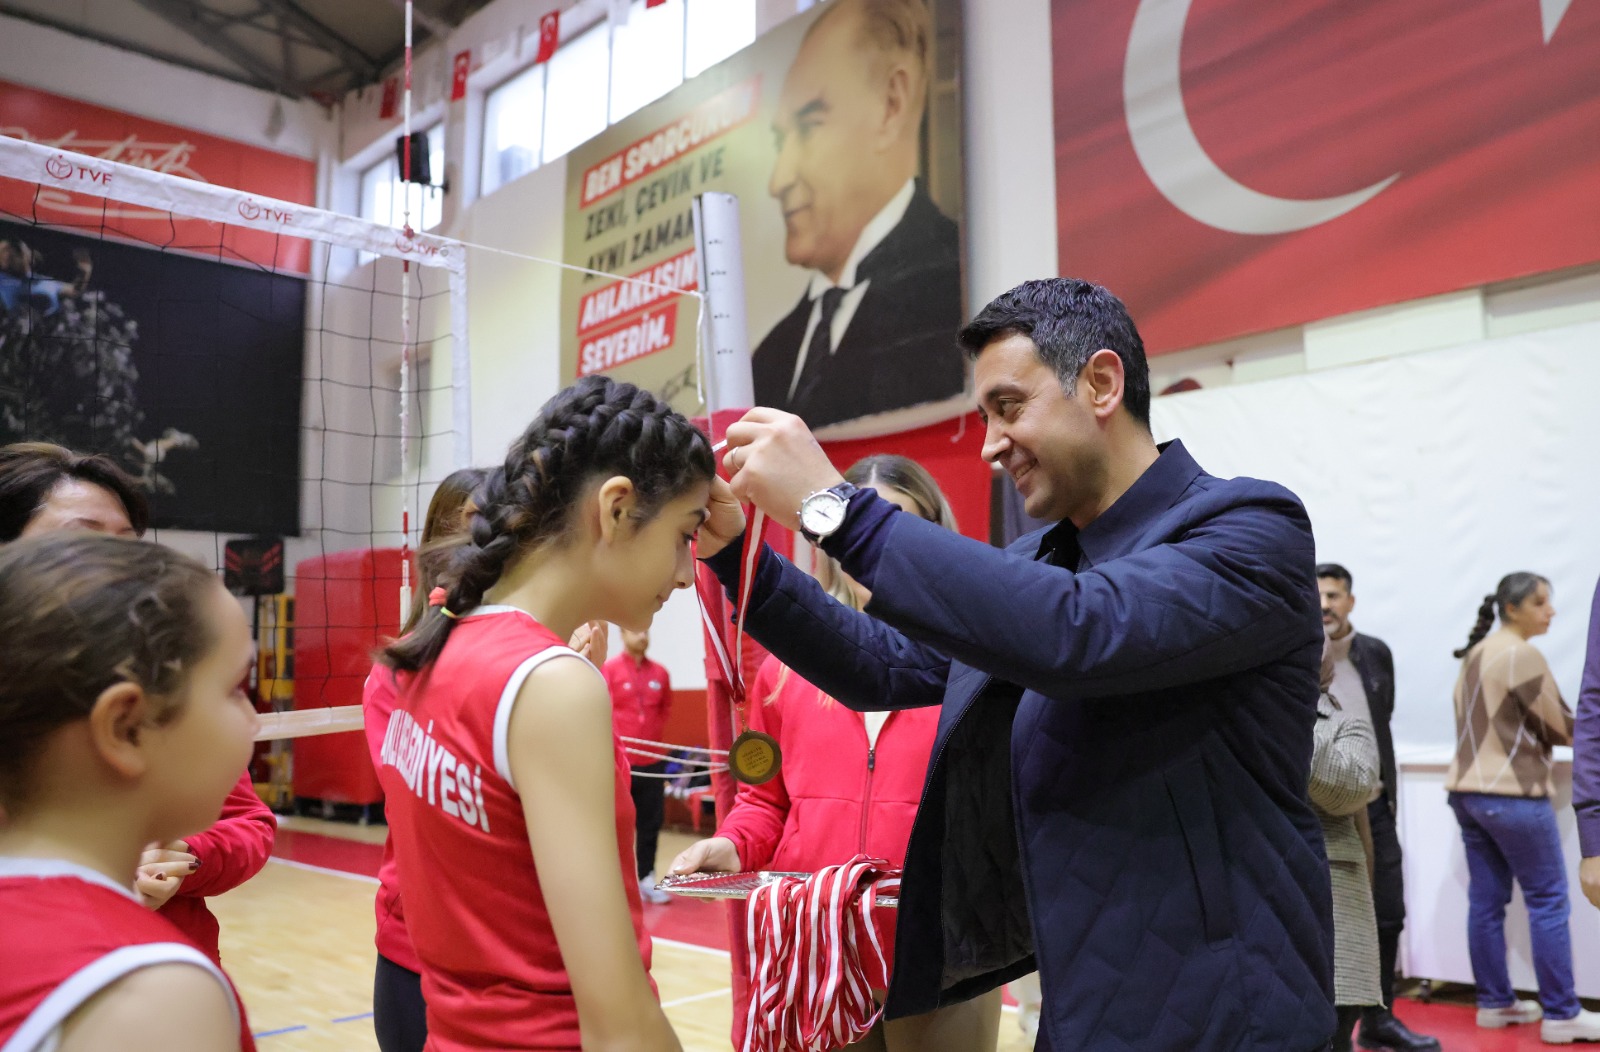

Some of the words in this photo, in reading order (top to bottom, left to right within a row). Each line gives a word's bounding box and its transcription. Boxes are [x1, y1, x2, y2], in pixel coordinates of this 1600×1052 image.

[77, 166, 113, 185] TVF
[585, 155, 622, 202] BEN
[700, 146, 727, 184] VE
[263, 208, 293, 224] TVF
[416, 242, 438, 256] TVF
[582, 240, 627, 284] AYNI
[630, 207, 695, 262] ZAMAN
[582, 313, 671, 374] SEVERİM.
